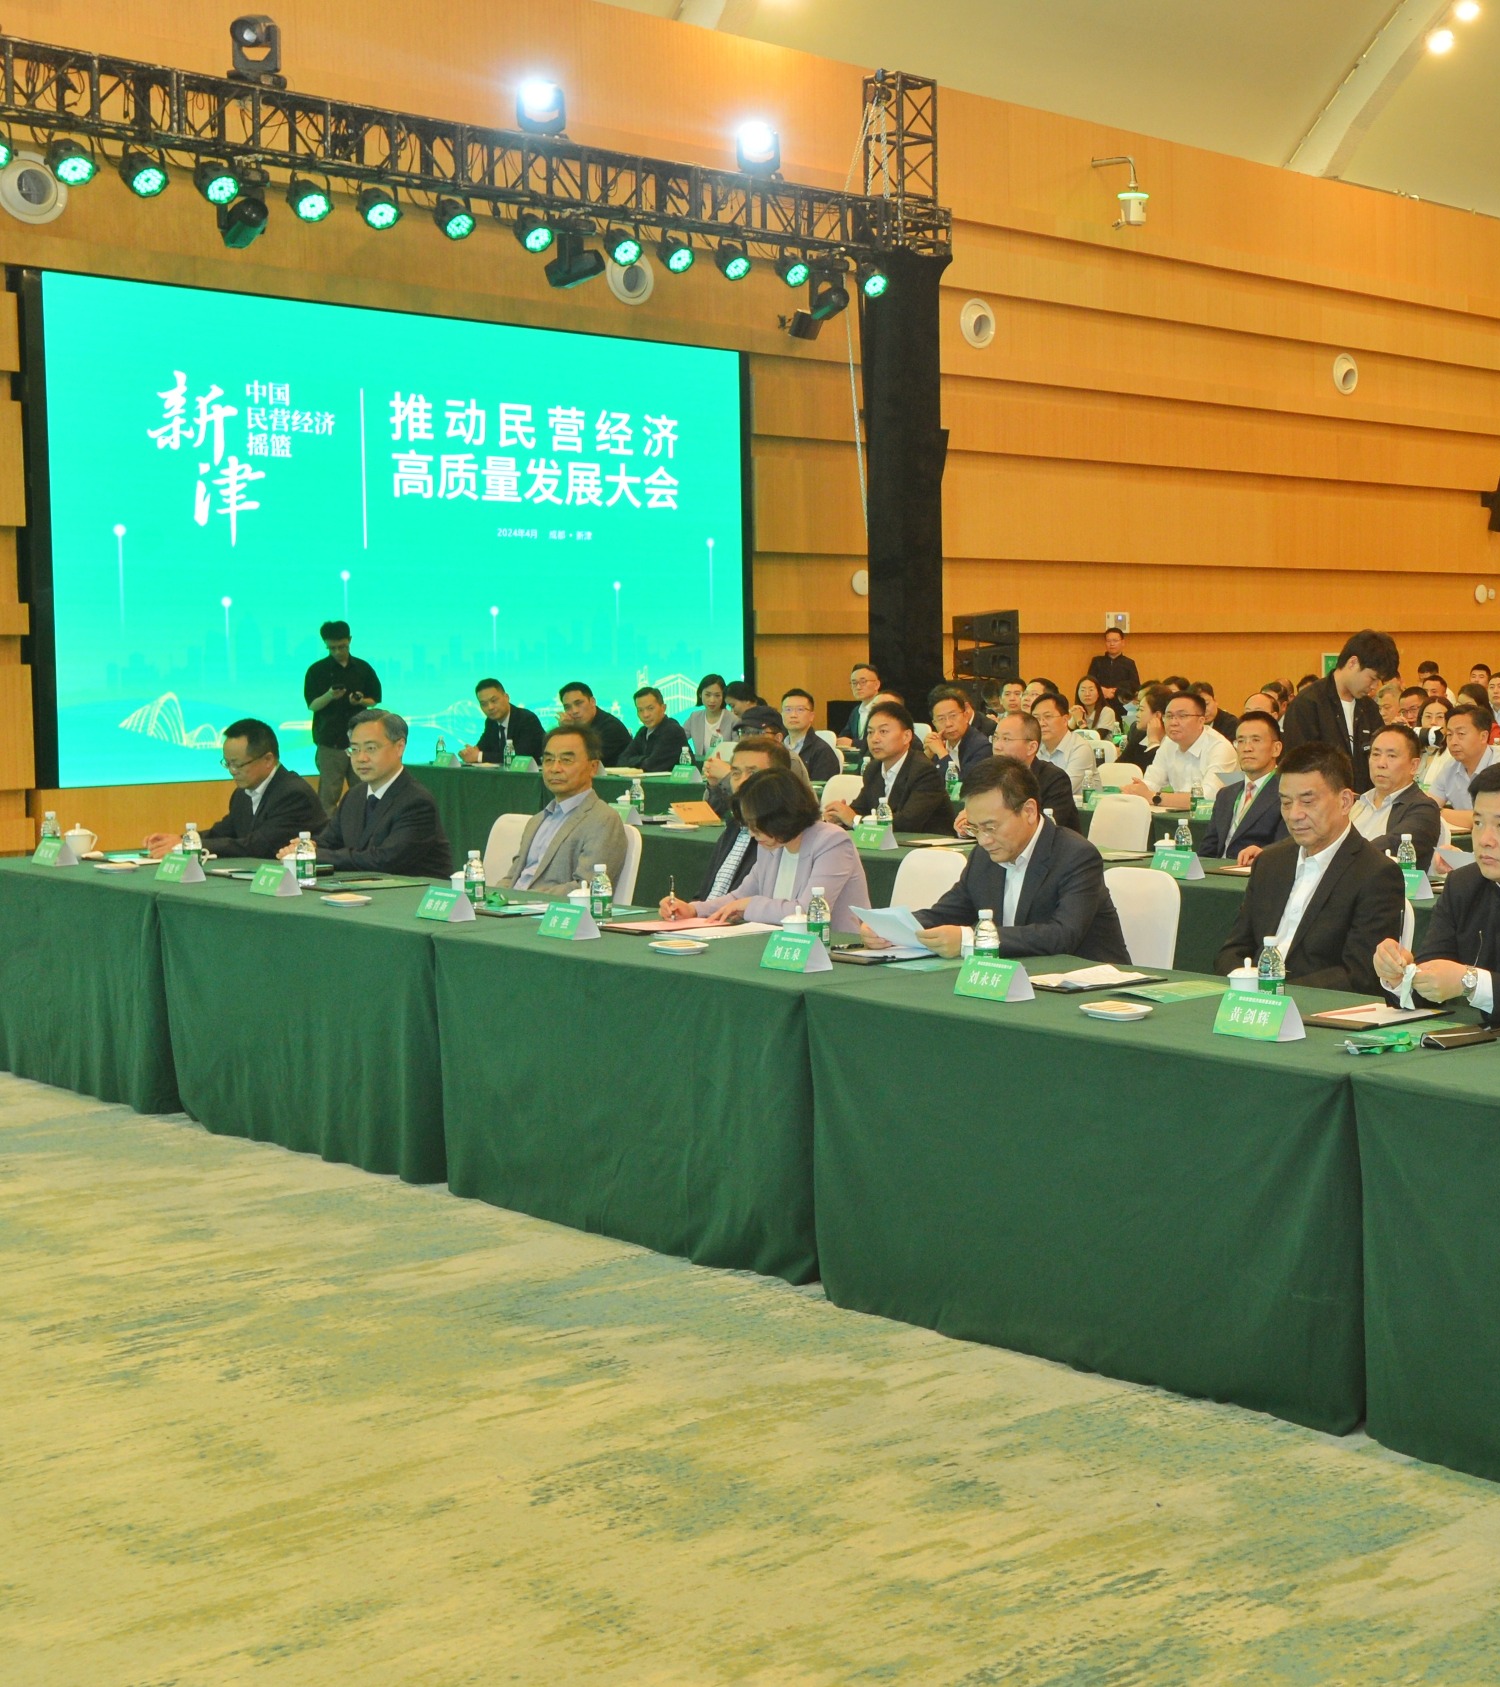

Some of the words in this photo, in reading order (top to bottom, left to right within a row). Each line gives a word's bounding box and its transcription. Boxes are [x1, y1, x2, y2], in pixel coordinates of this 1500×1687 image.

[245, 380, 290, 406] 中国
[246, 407, 335, 436] 民营经济
[389, 391, 679, 459] 推动民营经济
[246, 432, 292, 458] 摇篮
[391, 449, 679, 511] 高质量发展大会
[967, 969, 1003, 988] 刘永好
[1228, 1006, 1271, 1027] 黄剑辉
